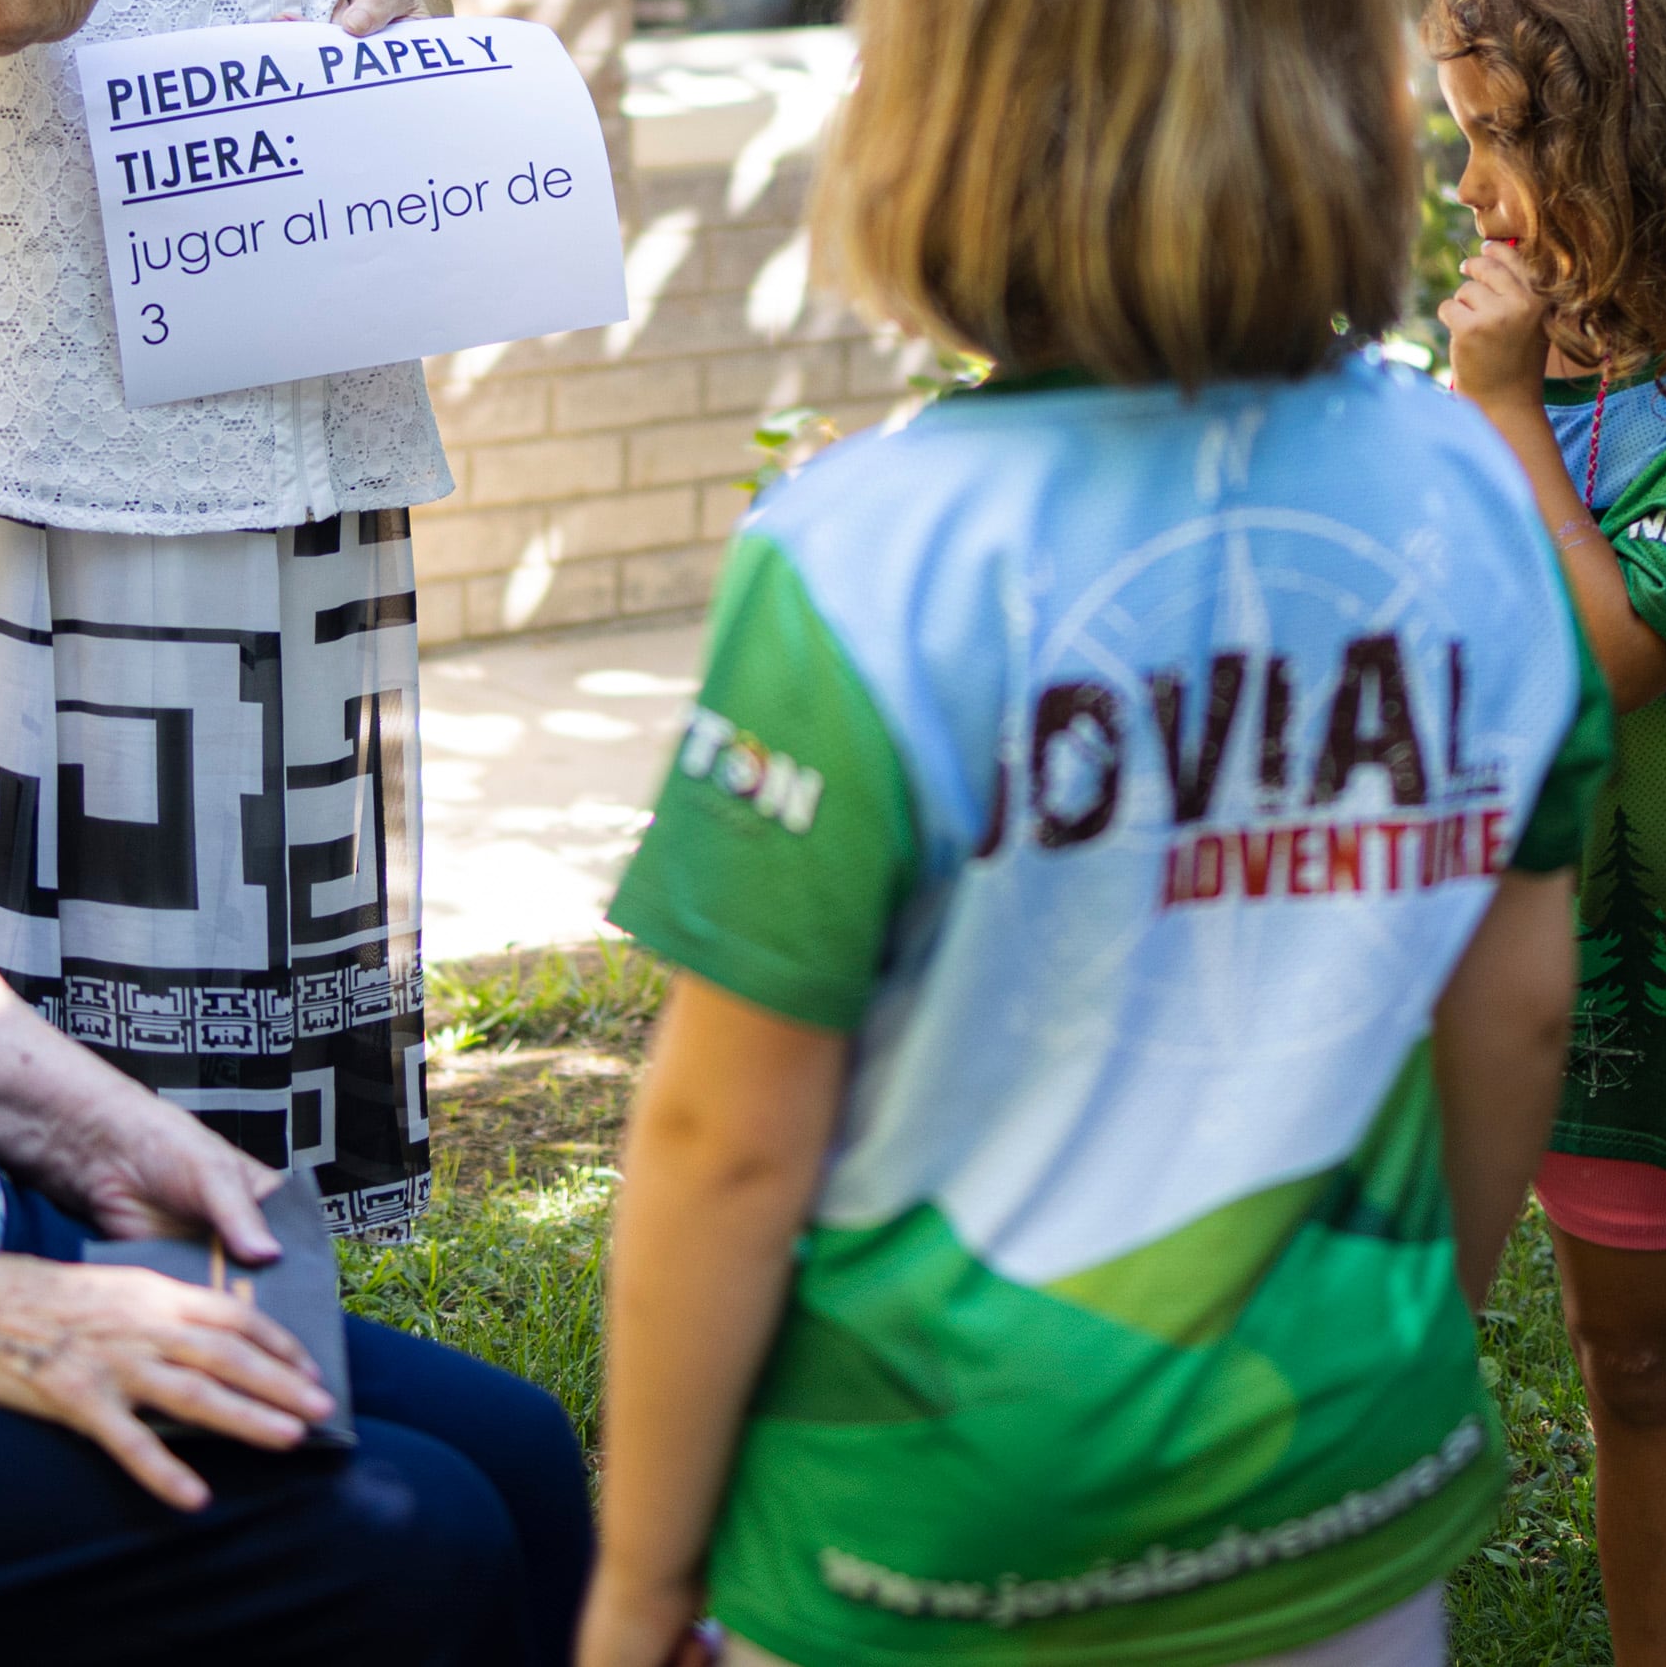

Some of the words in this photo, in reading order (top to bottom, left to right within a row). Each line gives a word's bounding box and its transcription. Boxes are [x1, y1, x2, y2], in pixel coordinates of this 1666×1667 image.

[107, 54, 306, 121] PIEDRA,
[318, 37, 465, 85] PAPEL
[467, 35, 498, 63] Y
[115, 130, 300, 195] TIJERA:
[130, 219, 265, 286] jugar
[283, 199, 328, 246] al
[345, 178, 489, 234] mejor
[507, 161, 573, 206] de
[140, 303, 170, 346] 3
